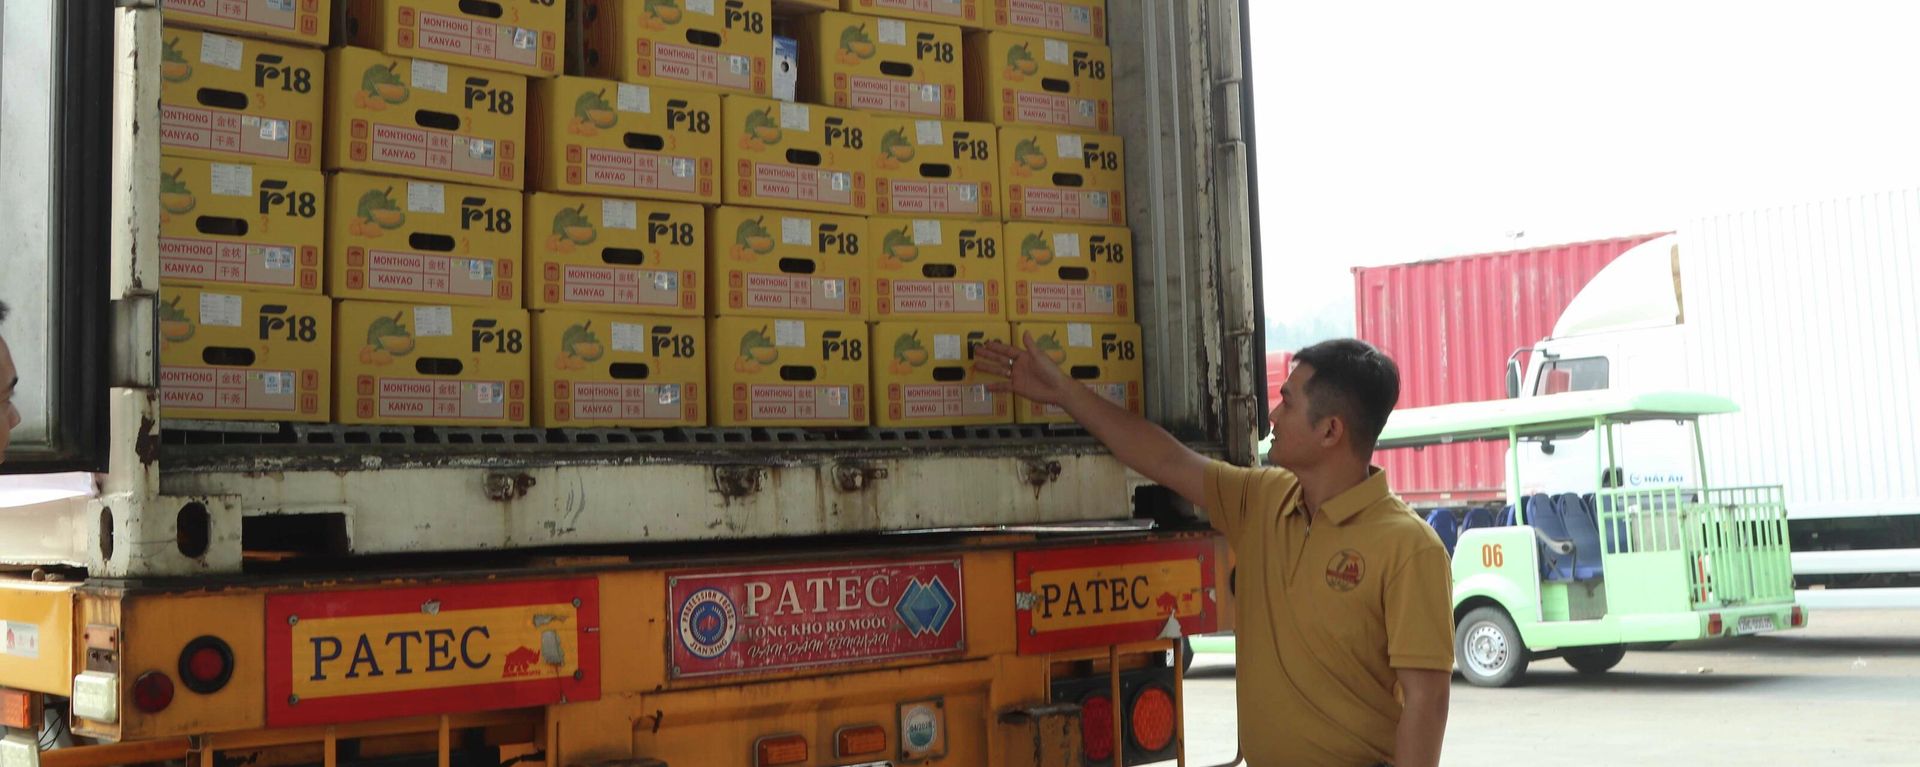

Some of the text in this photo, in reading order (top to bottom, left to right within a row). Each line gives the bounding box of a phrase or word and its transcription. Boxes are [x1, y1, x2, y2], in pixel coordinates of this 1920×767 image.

[424, 17, 469, 32] MONTHONG
[428, 35, 461, 48] KANYAO
[657, 47, 695, 60] MONTHONG
[662, 63, 689, 76] KANYAO
[853, 81, 888, 91] MONTHONG
[857, 96, 883, 106] KANYAO
[377, 130, 424, 144] MONTHONG
[382, 148, 416, 160] KANYAO
[590, 152, 632, 165] MONTHONG
[595, 171, 626, 181] KANYAO
[759, 167, 795, 179] MONTHONG
[762, 184, 790, 194] KANYAO
[894, 183, 927, 194] MONTHONG
[1027, 191, 1059, 200] MONTHONG
[898, 200, 922, 209] KANYAO
[1031, 205, 1055, 215] KANYAO
[160, 243, 213, 255] MONTHONG
[374, 256, 421, 268] MONTHONG
[165, 263, 203, 273] KANYAO
[378, 275, 413, 286] KANYAO
[568, 270, 611, 281] MONTHONG
[750, 278, 788, 288] MONTHONG
[572, 287, 605, 297] KANYAO
[897, 284, 932, 294] MONTHONG
[1034, 286, 1065, 296] MONTHONG
[754, 293, 782, 303] KANYAO
[901, 300, 926, 308] KANYAO
[1038, 301, 1061, 310] KANYAO
[160, 371, 212, 383] MONTHONG
[383, 383, 431, 394] MONTHONG
[577, 387, 619, 397] MONTHONG
[907, 389, 941, 398] MONTHONG
[164, 391, 203, 402] KANYAO
[754, 389, 792, 399] MONTHONG
[389, 402, 423, 412] KANYAO
[582, 405, 612, 414] KANYAO
[759, 405, 787, 415] KANYAO
[911, 404, 937, 413] KANYAO
[1482, 544, 1503, 568] 06
[744, 575, 891, 617] PATEC
[1042, 576, 1150, 618] PATEC
[791, 622, 822, 636] KHO
[690, 639, 728, 655] JIANXING
[309, 626, 492, 681] PATEC
